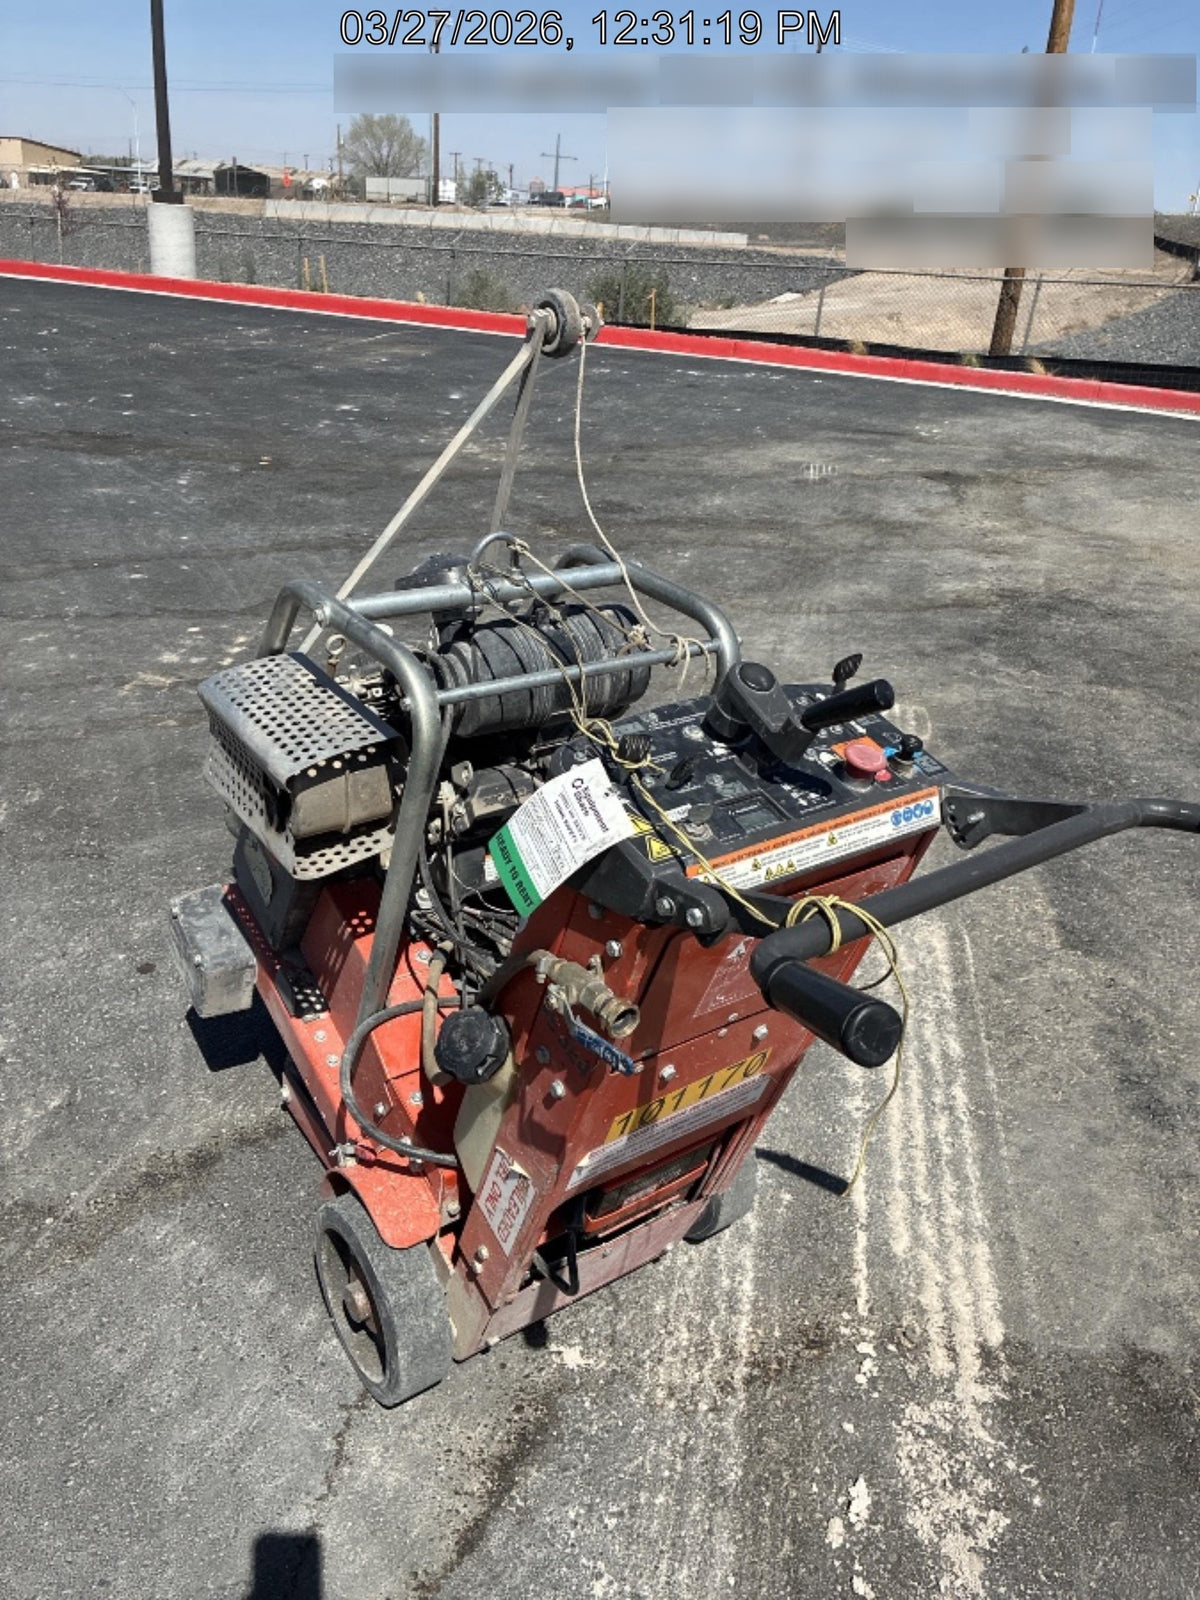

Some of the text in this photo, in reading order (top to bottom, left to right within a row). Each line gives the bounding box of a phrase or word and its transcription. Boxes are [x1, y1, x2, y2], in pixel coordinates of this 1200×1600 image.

[496, 833, 534, 908] READY TO RENT
